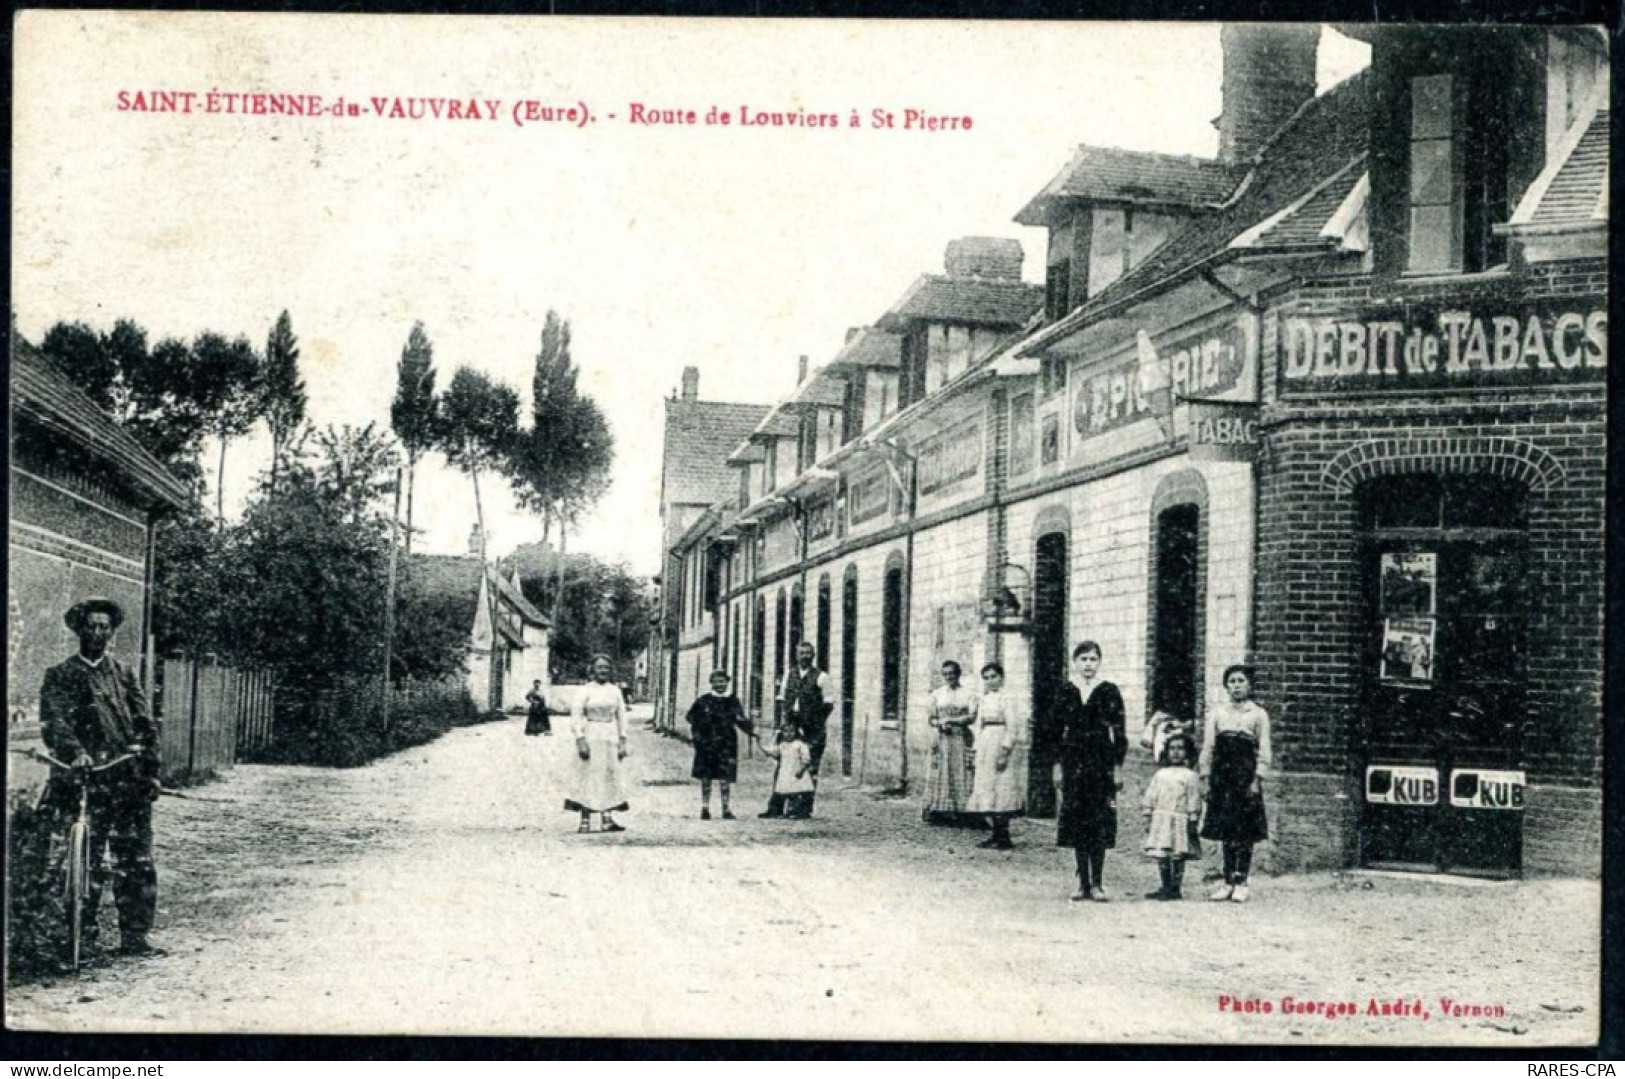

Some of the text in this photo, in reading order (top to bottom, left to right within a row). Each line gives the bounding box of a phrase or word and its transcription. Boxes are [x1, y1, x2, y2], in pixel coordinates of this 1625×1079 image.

[1403, 327, 1440, 374] de
[1440, 309, 1607, 373] TABACS
[1394, 777, 1437, 803] KUB
[1480, 780, 1525, 807] KUB
